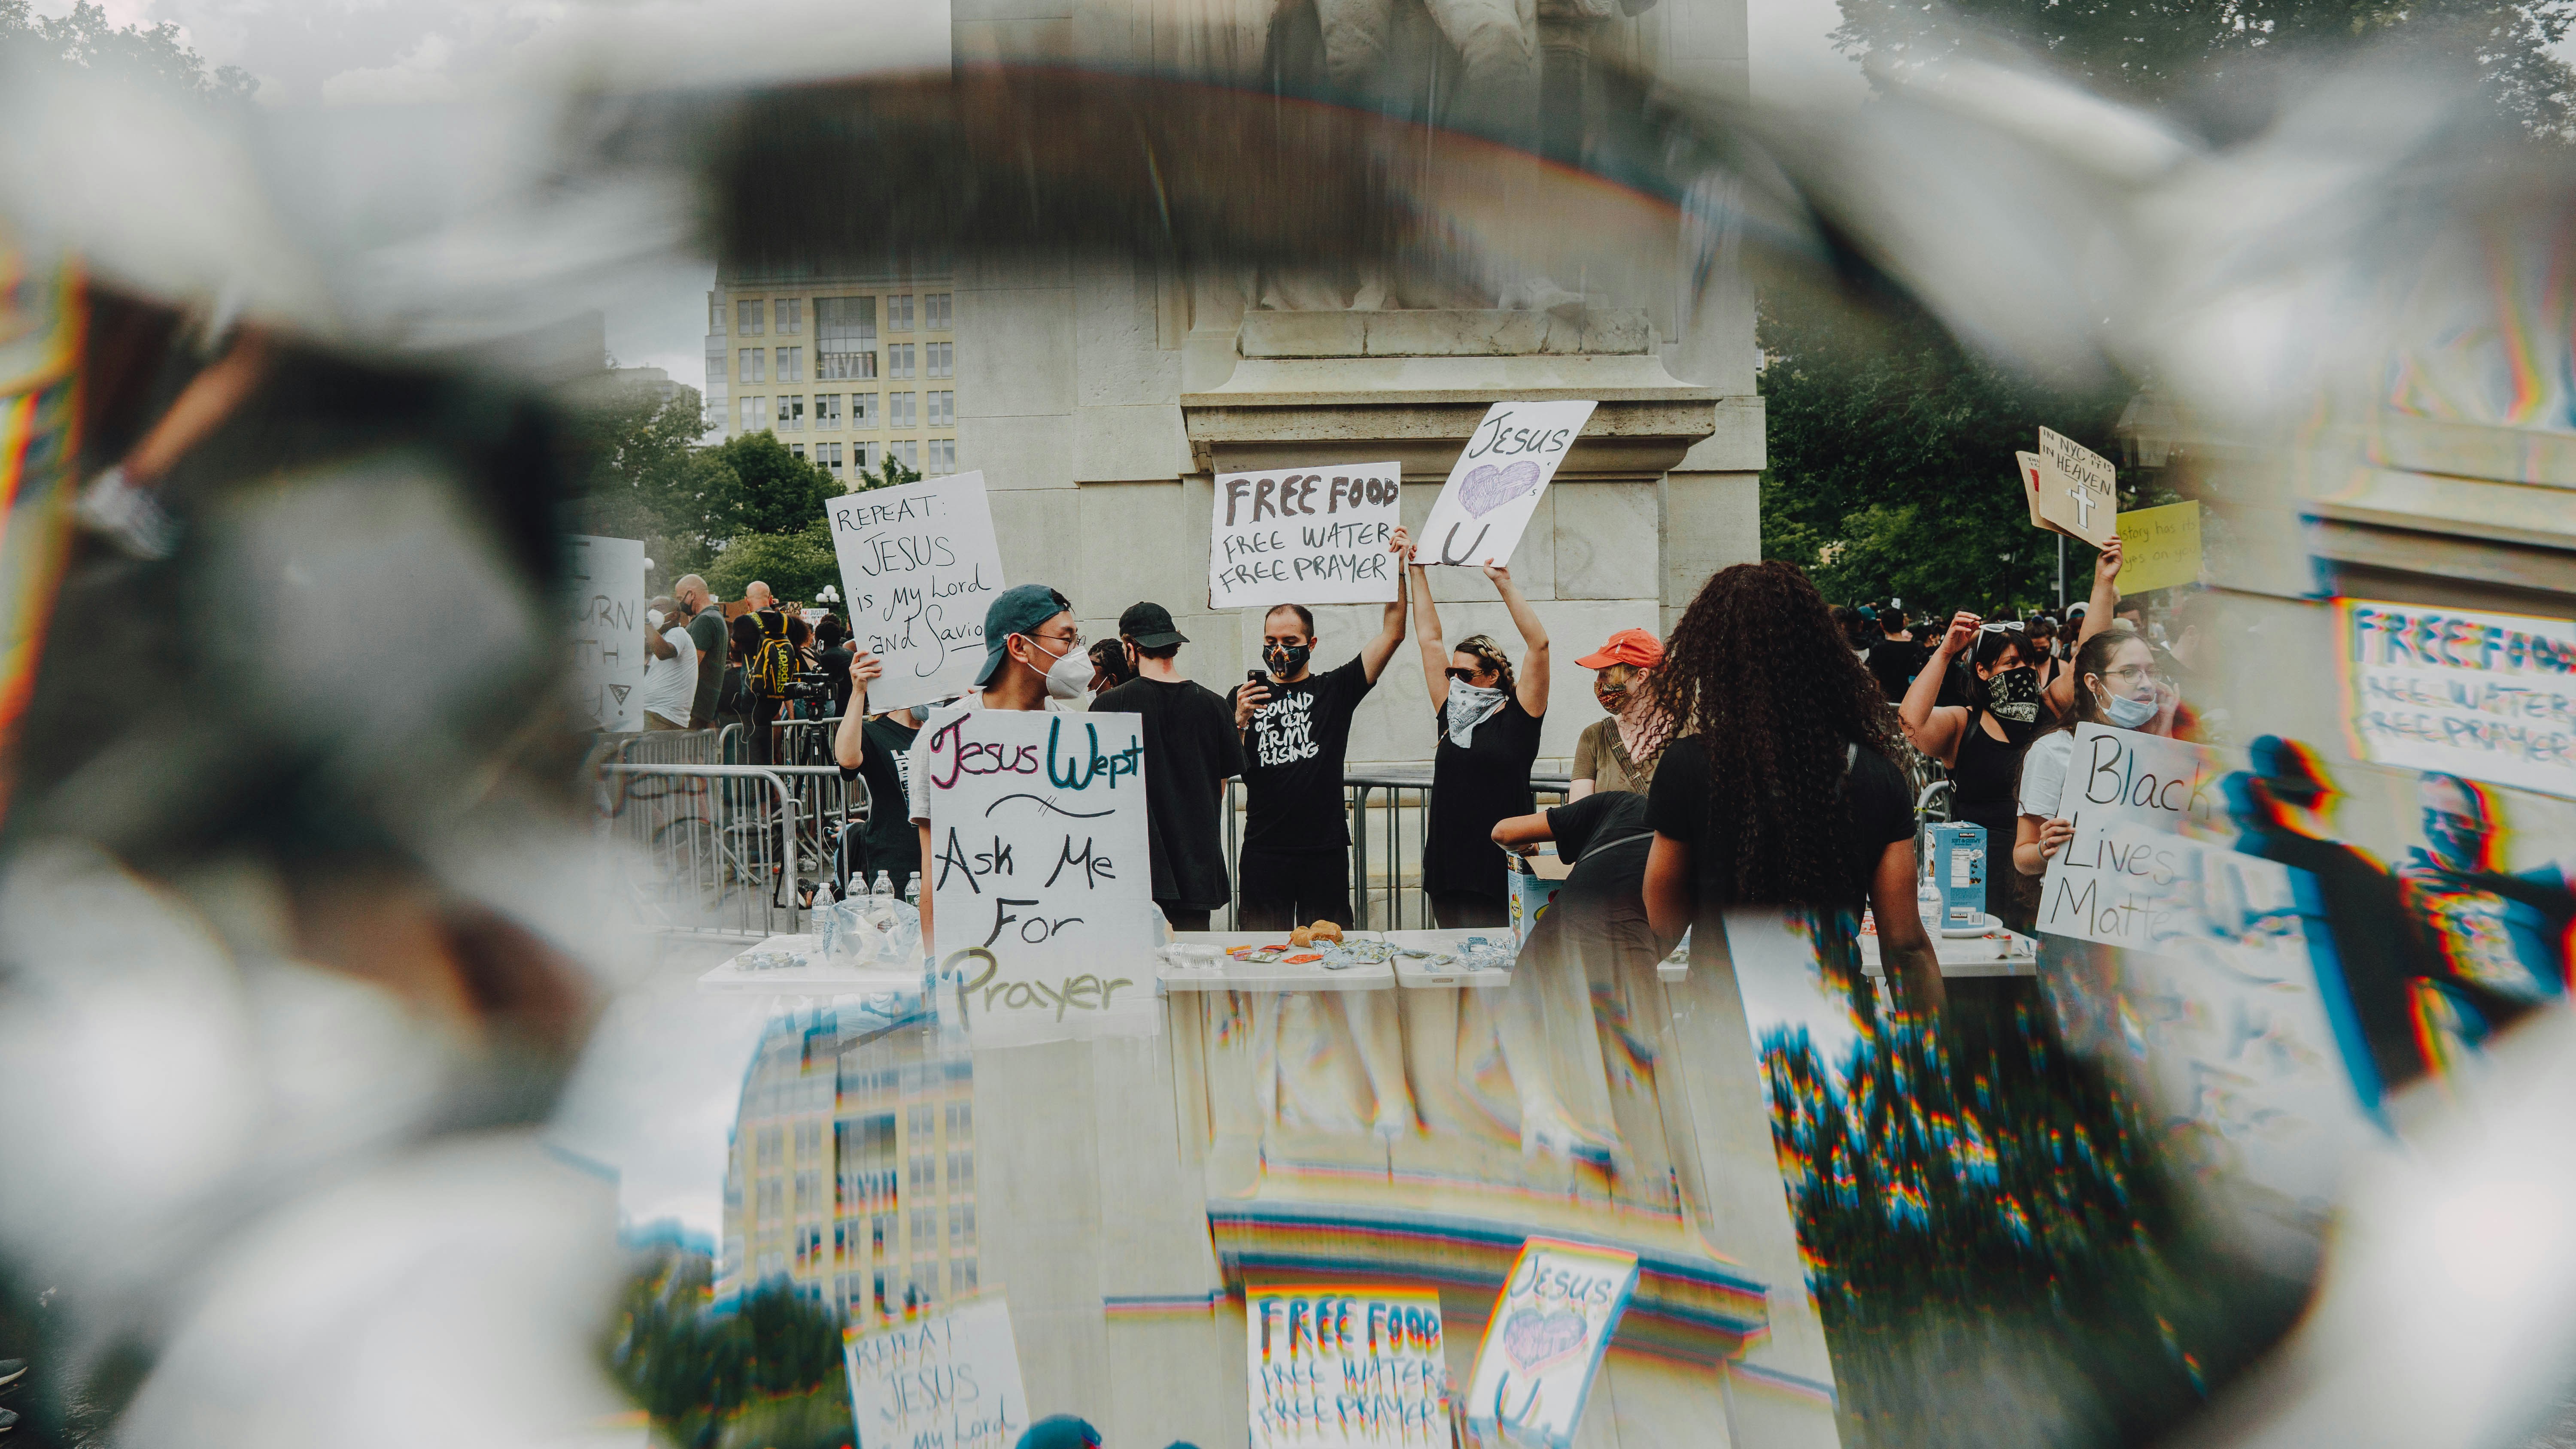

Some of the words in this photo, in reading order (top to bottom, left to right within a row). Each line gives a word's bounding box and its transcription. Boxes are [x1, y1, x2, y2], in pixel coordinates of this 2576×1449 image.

[2042, 445, 2054, 458] IN
[2057, 453, 2111, 496] HEAVEN
[2043, 429, 2054, 440] IN
[2060, 437, 2085, 461] NYC
[2091, 460, 2101, 469] IT
[2104, 462, 2111, 472] IS
[837, 494, 946, 532] REPEAT:
[1225, 475, 1321, 526] FREE
[1327, 476, 1399, 514] FOOD
[1223, 530, 1286, 564] FREE
[1302, 522, 1391, 549] WATER
[1442, 522, 1491, 566] U
[2155, 521, 2176, 534] has
[862, 532, 955, 576] JESUS
[1218, 559, 1289, 593] FREE
[1293, 553, 1387, 583] PRAYER
[2153, 552, 2168, 560] on
[855, 587, 873, 612] is
[932, 562, 992, 597] Lord
[1253, 691, 1314, 719] SOUND
[930, 712, 1039, 790] Jesus
[1047, 716, 1143, 790] Wept
[1257, 721, 1312, 752] ARMY
[1258, 741, 1319, 767] RISING
[1045, 834, 1116, 889] Me
[2063, 811, 2175, 885] Lives
[983, 897, 1084, 948] For
[2050, 876, 2172, 941] Matte
[939, 946, 1133, 1033] Prayer
[1258, 1294, 1358, 1363] FREE
[1367, 1300, 1440, 1355] FOOD
